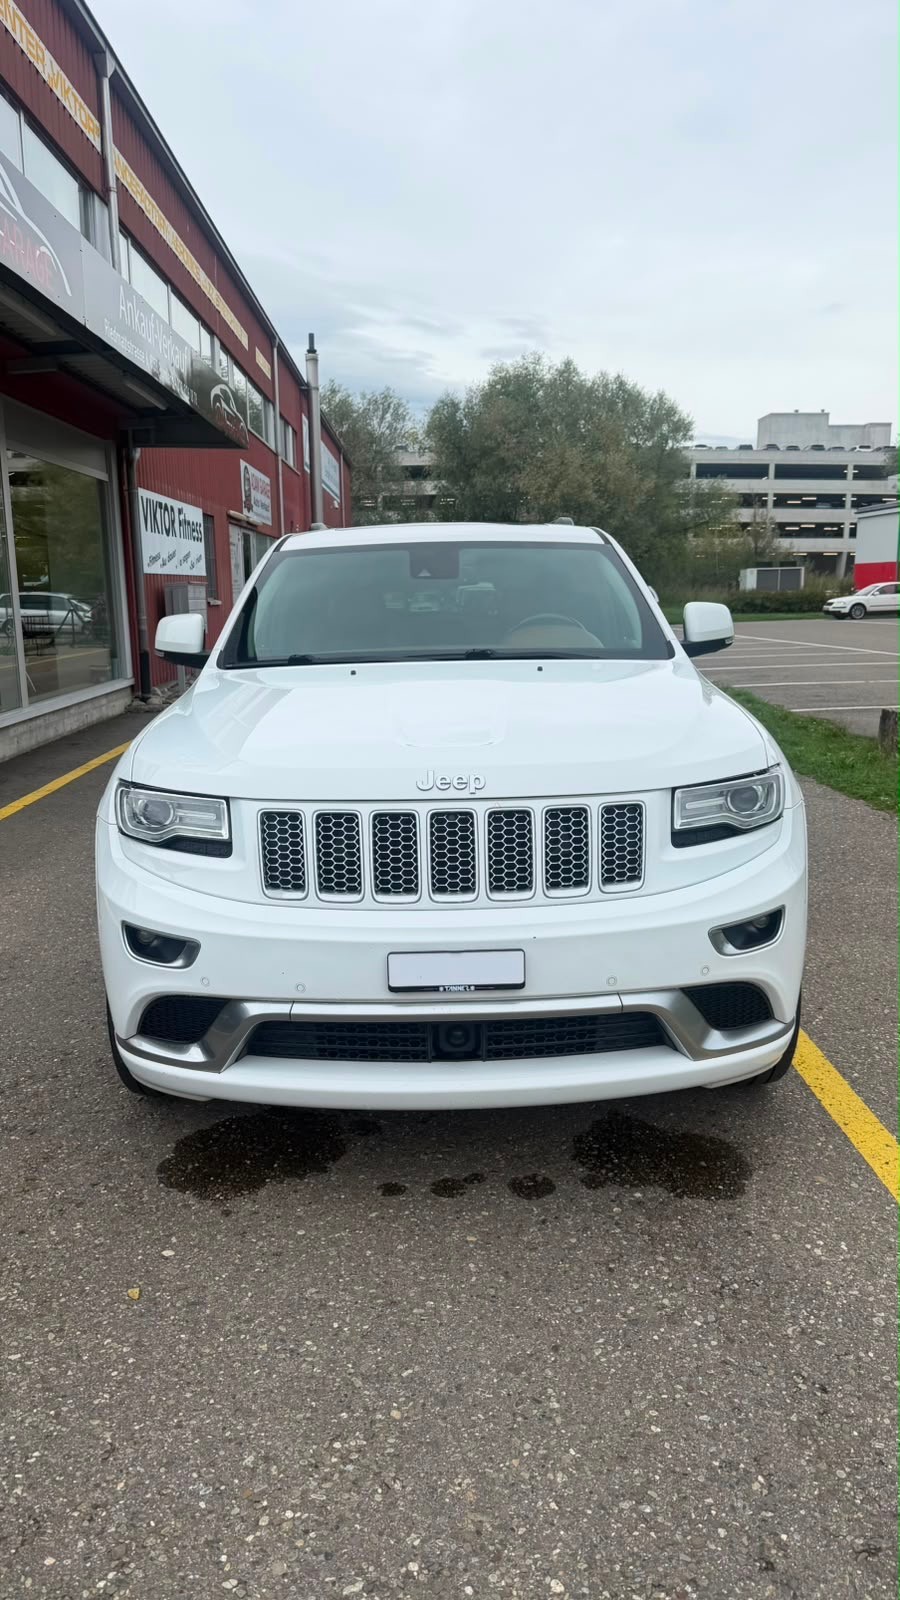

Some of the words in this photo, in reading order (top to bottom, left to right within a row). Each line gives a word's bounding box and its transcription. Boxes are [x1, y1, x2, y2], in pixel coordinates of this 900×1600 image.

[119, 285, 188, 376] Ankauf-Verkauf
[140, 495, 177, 538] VIKTOR
[178, 507, 203, 543] Fitness
[416, 769, 486, 794] Jeep
